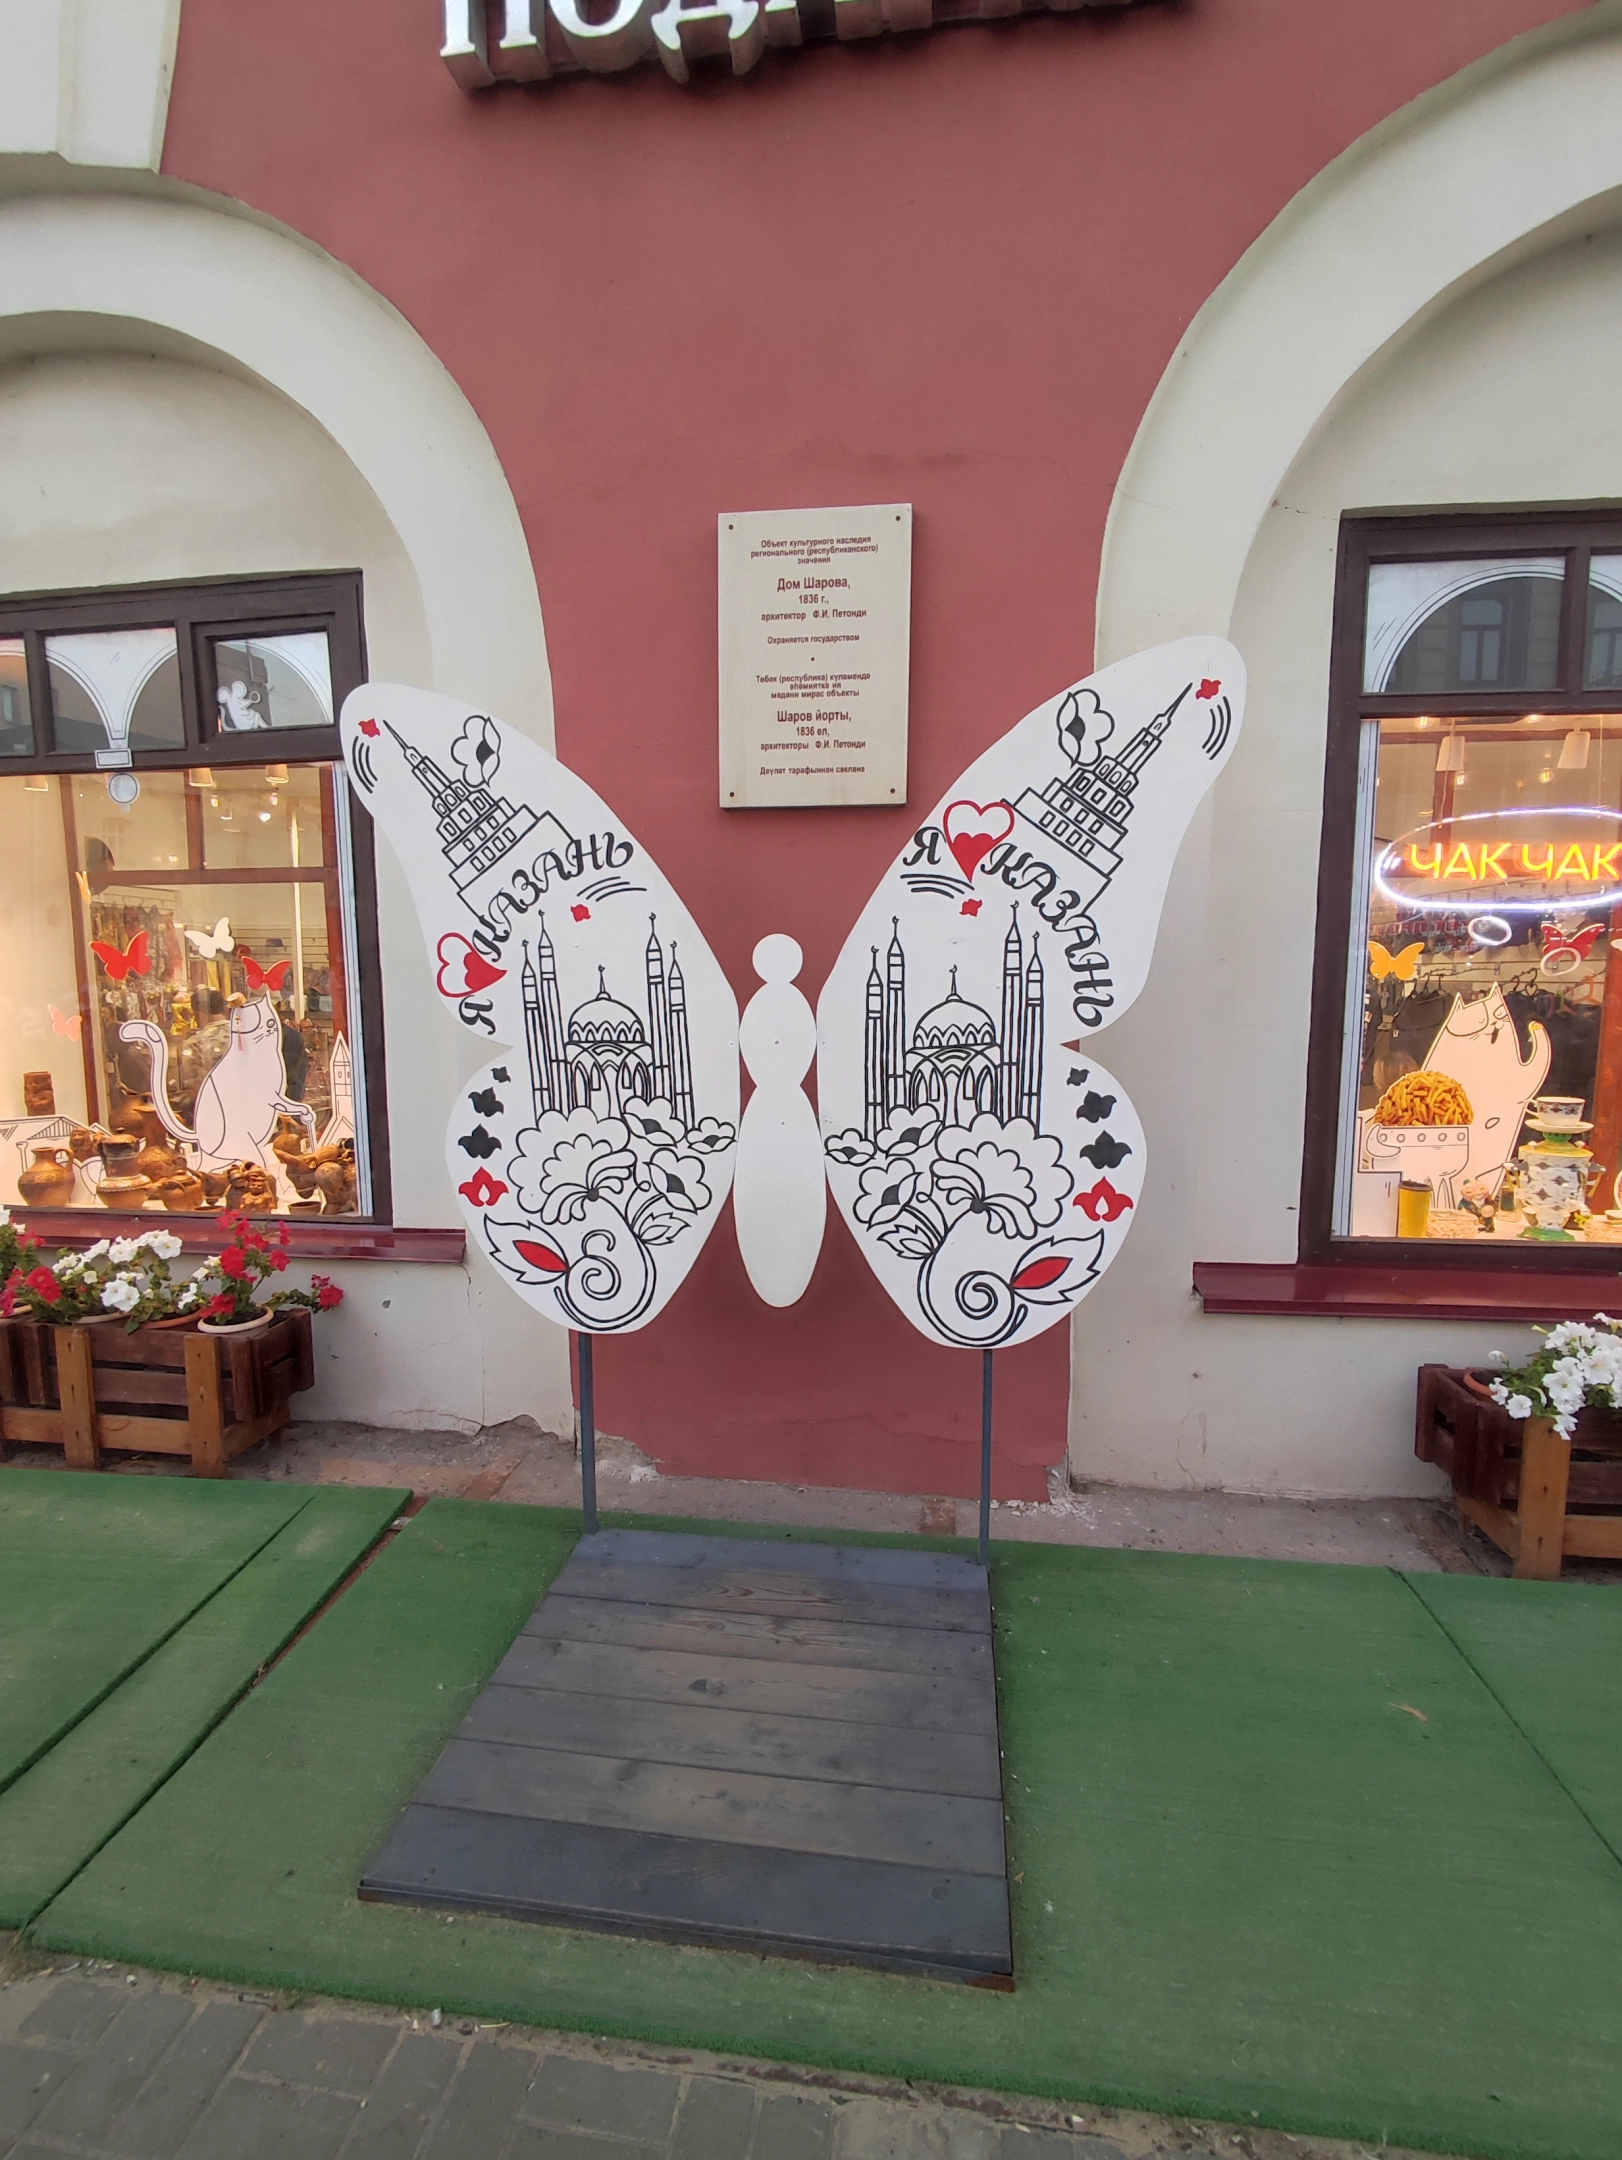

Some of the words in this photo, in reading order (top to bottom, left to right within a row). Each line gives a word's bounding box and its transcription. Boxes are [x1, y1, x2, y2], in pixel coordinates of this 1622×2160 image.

[761, 540, 788, 548] Объект
[790, 538, 834, 548] культурного
[836, 536, 871, 545] наследия
[751, 548, 805, 558] регионального
[807, 544, 879, 556] (республиканского)
[777, 578, 800, 592] Дом
[804, 577, 851, 590] Шарова,
[799, 594, 819, 604] 1836
[761, 612, 806, 622] архитектор
[812, 610, 830, 618] Ф.И.
[832, 609, 867, 618] Петонди
[768, 636, 808, 645] Охраняется
[811, 634, 859, 644] государством
[779, 674, 828, 684] (республика)
[777, 710, 812, 724] Шаров
[815, 709, 852, 723] йорты,
[796, 727, 815, 736] 1836
[817, 728, 830, 737] ел,
[761, 742, 809, 752] архитекторы
[815, 740, 831, 749] Ф.И.
[833, 740, 865, 749] Петонди
[788, 767, 834, 775] тарафыннан
[1410, 842, 1512, 880] ЧАК
[1521, 842, 1622, 880] ЧАК
[472, 832, 634, 962] КАЗАНЬ
[902, 826, 947, 866] Я
[980, 842, 1115, 1027] КАЗАНЬ
[459, 995, 496, 1035] Я
